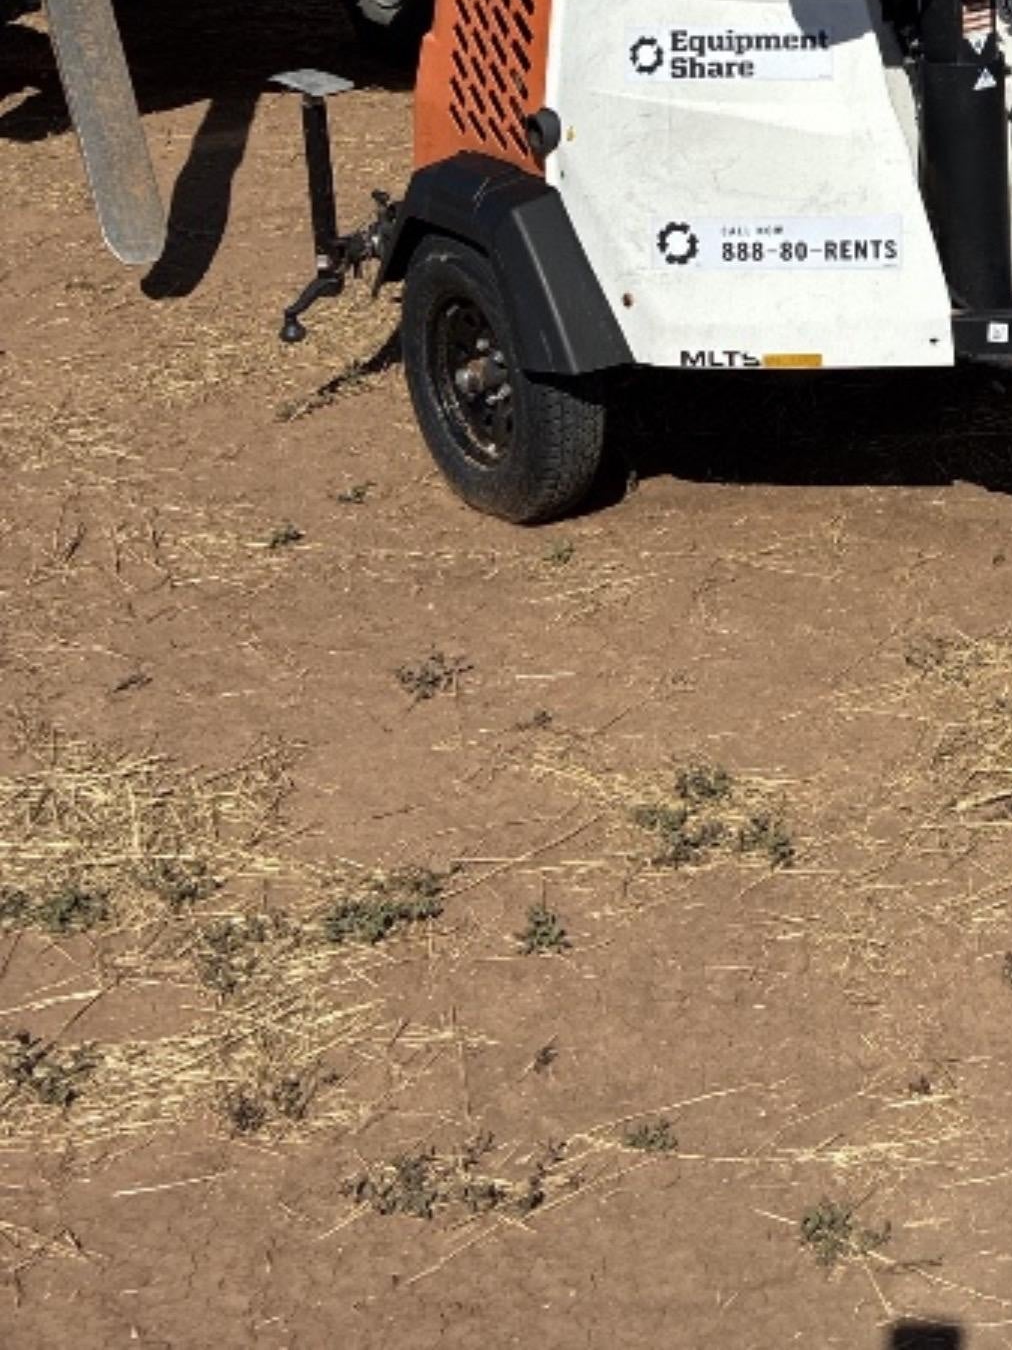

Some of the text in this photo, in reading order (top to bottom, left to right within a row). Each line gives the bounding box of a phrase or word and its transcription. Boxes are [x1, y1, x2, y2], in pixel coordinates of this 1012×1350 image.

[670, 29, 829, 57] Equipment
[670, 56, 755, 79] Share
[721, 238, 899, 262] 888-80-RENTS
